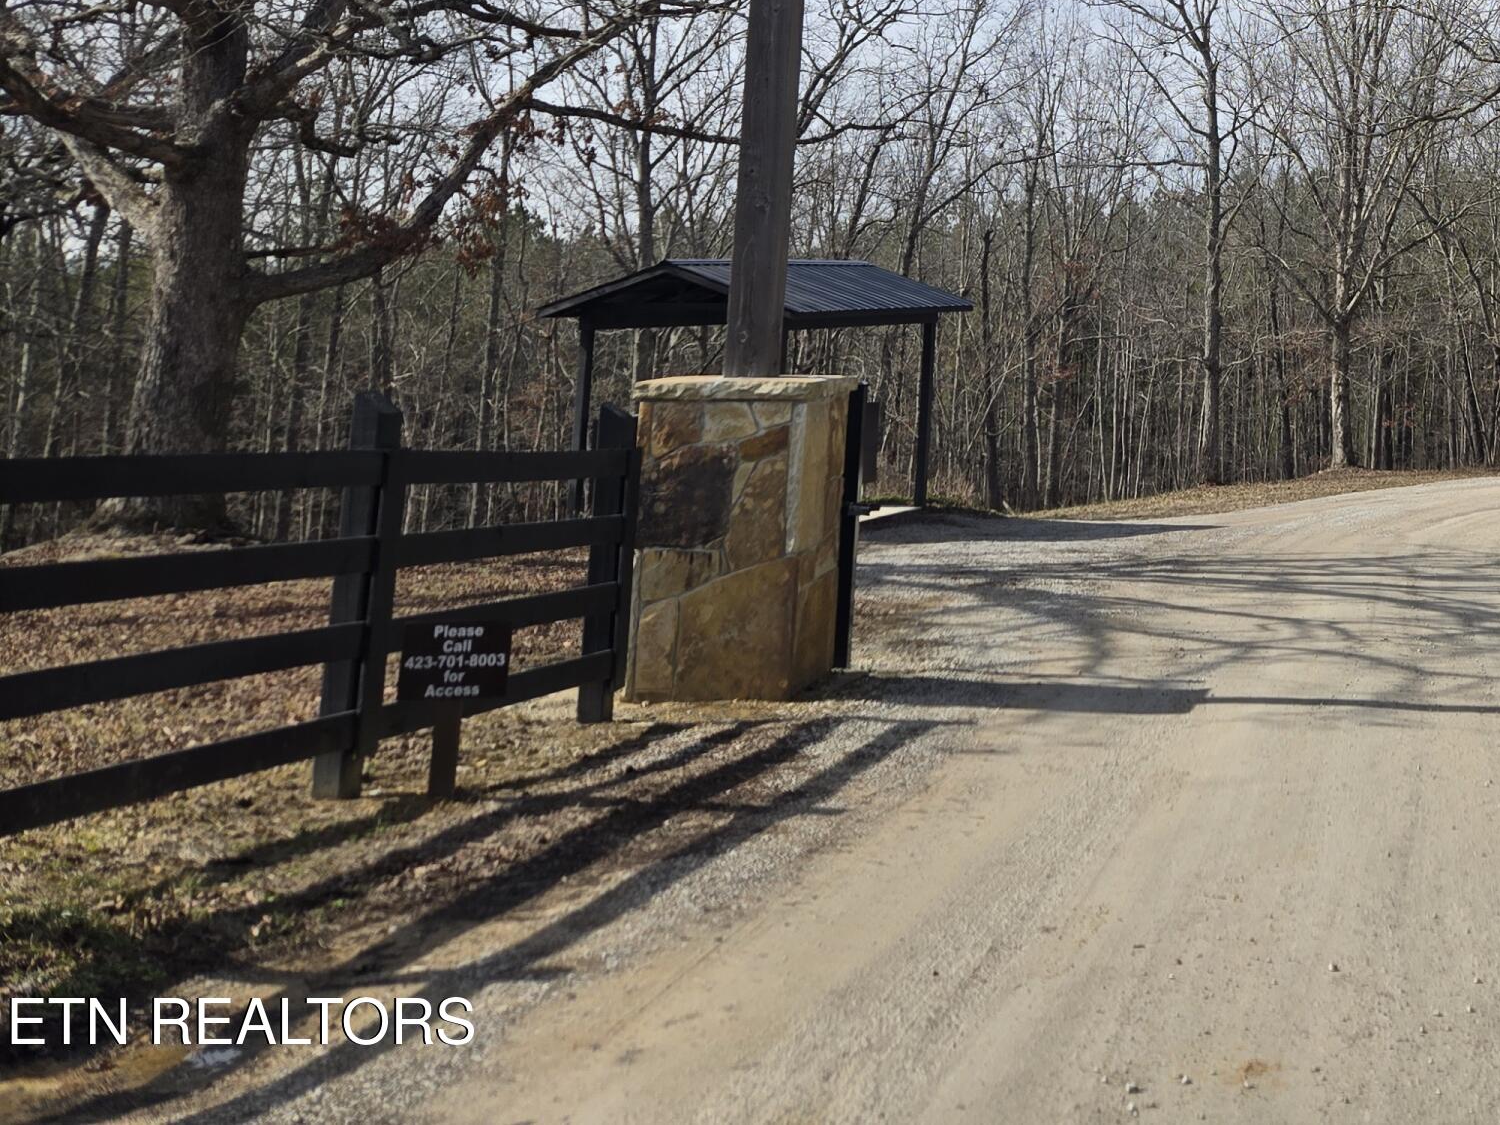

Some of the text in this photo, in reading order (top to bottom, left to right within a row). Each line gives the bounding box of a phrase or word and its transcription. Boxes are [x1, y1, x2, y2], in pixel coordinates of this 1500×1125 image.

[434, 625, 484, 639] Please
[443, 639, 473, 653] Call
[404, 653, 506, 669] 423-701-8003
[443, 670, 466, 683] for
[424, 684, 480, 698] Access
